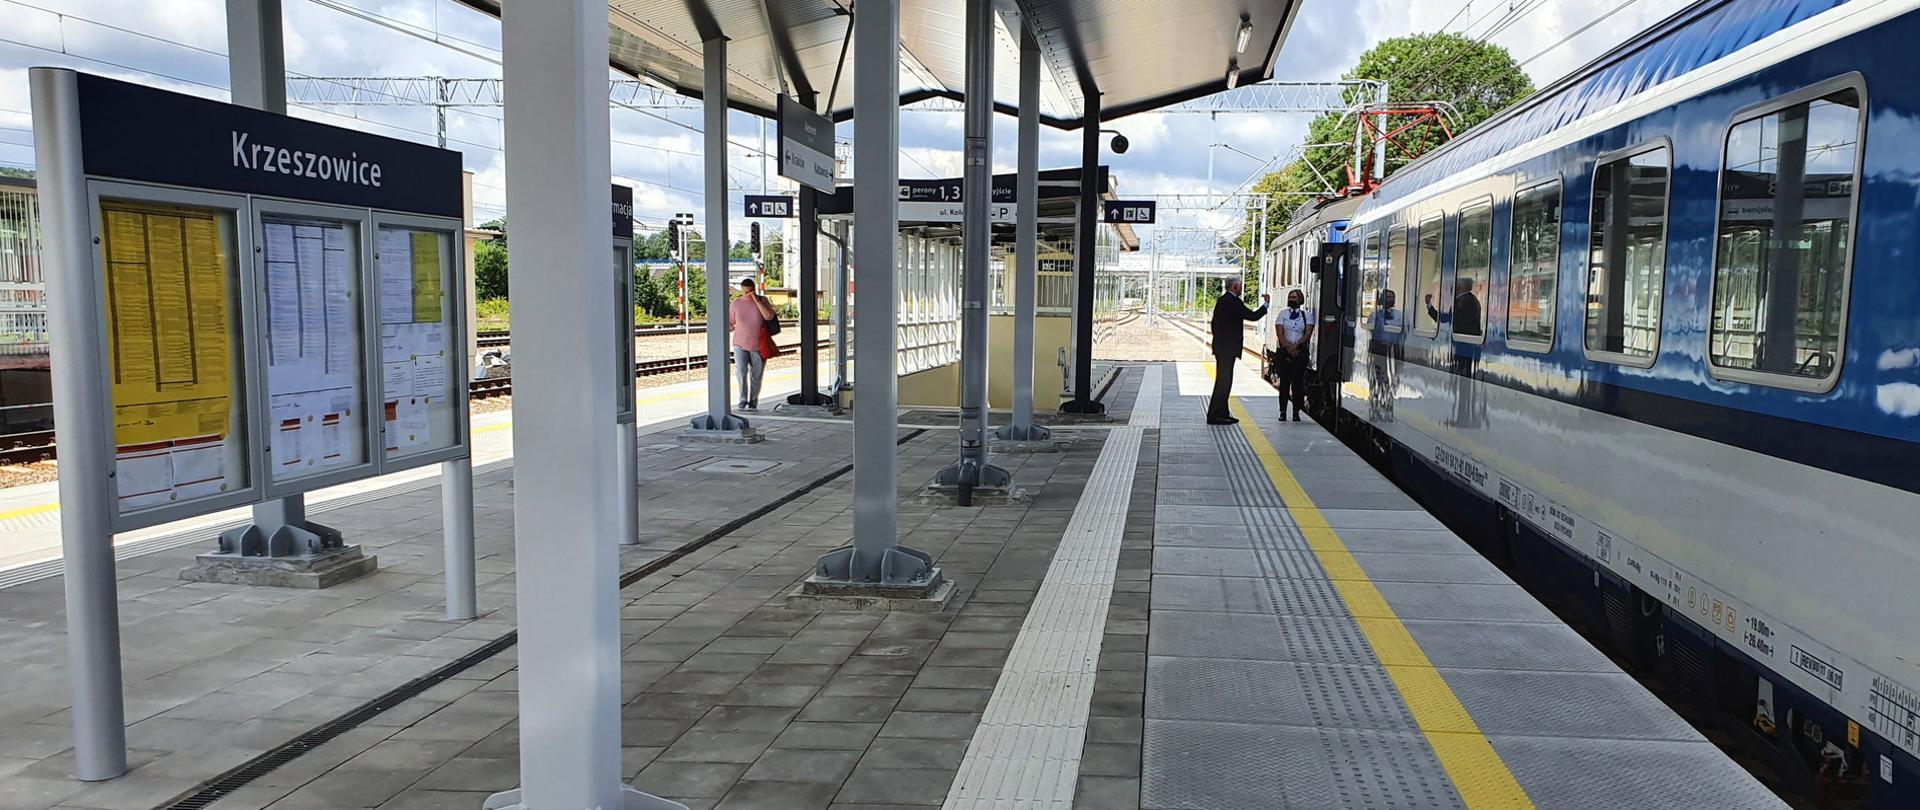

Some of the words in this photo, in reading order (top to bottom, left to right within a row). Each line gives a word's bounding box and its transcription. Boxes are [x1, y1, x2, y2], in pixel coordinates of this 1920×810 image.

[232, 131, 382, 187] Krzeszowice
[912, 186, 937, 195] perony
[992, 186, 1012, 196] yjście
[612, 200, 633, 220] macja
[1751, 617, 1770, 638] 19.00m
[1748, 634, 1769, 656] 26.40m
